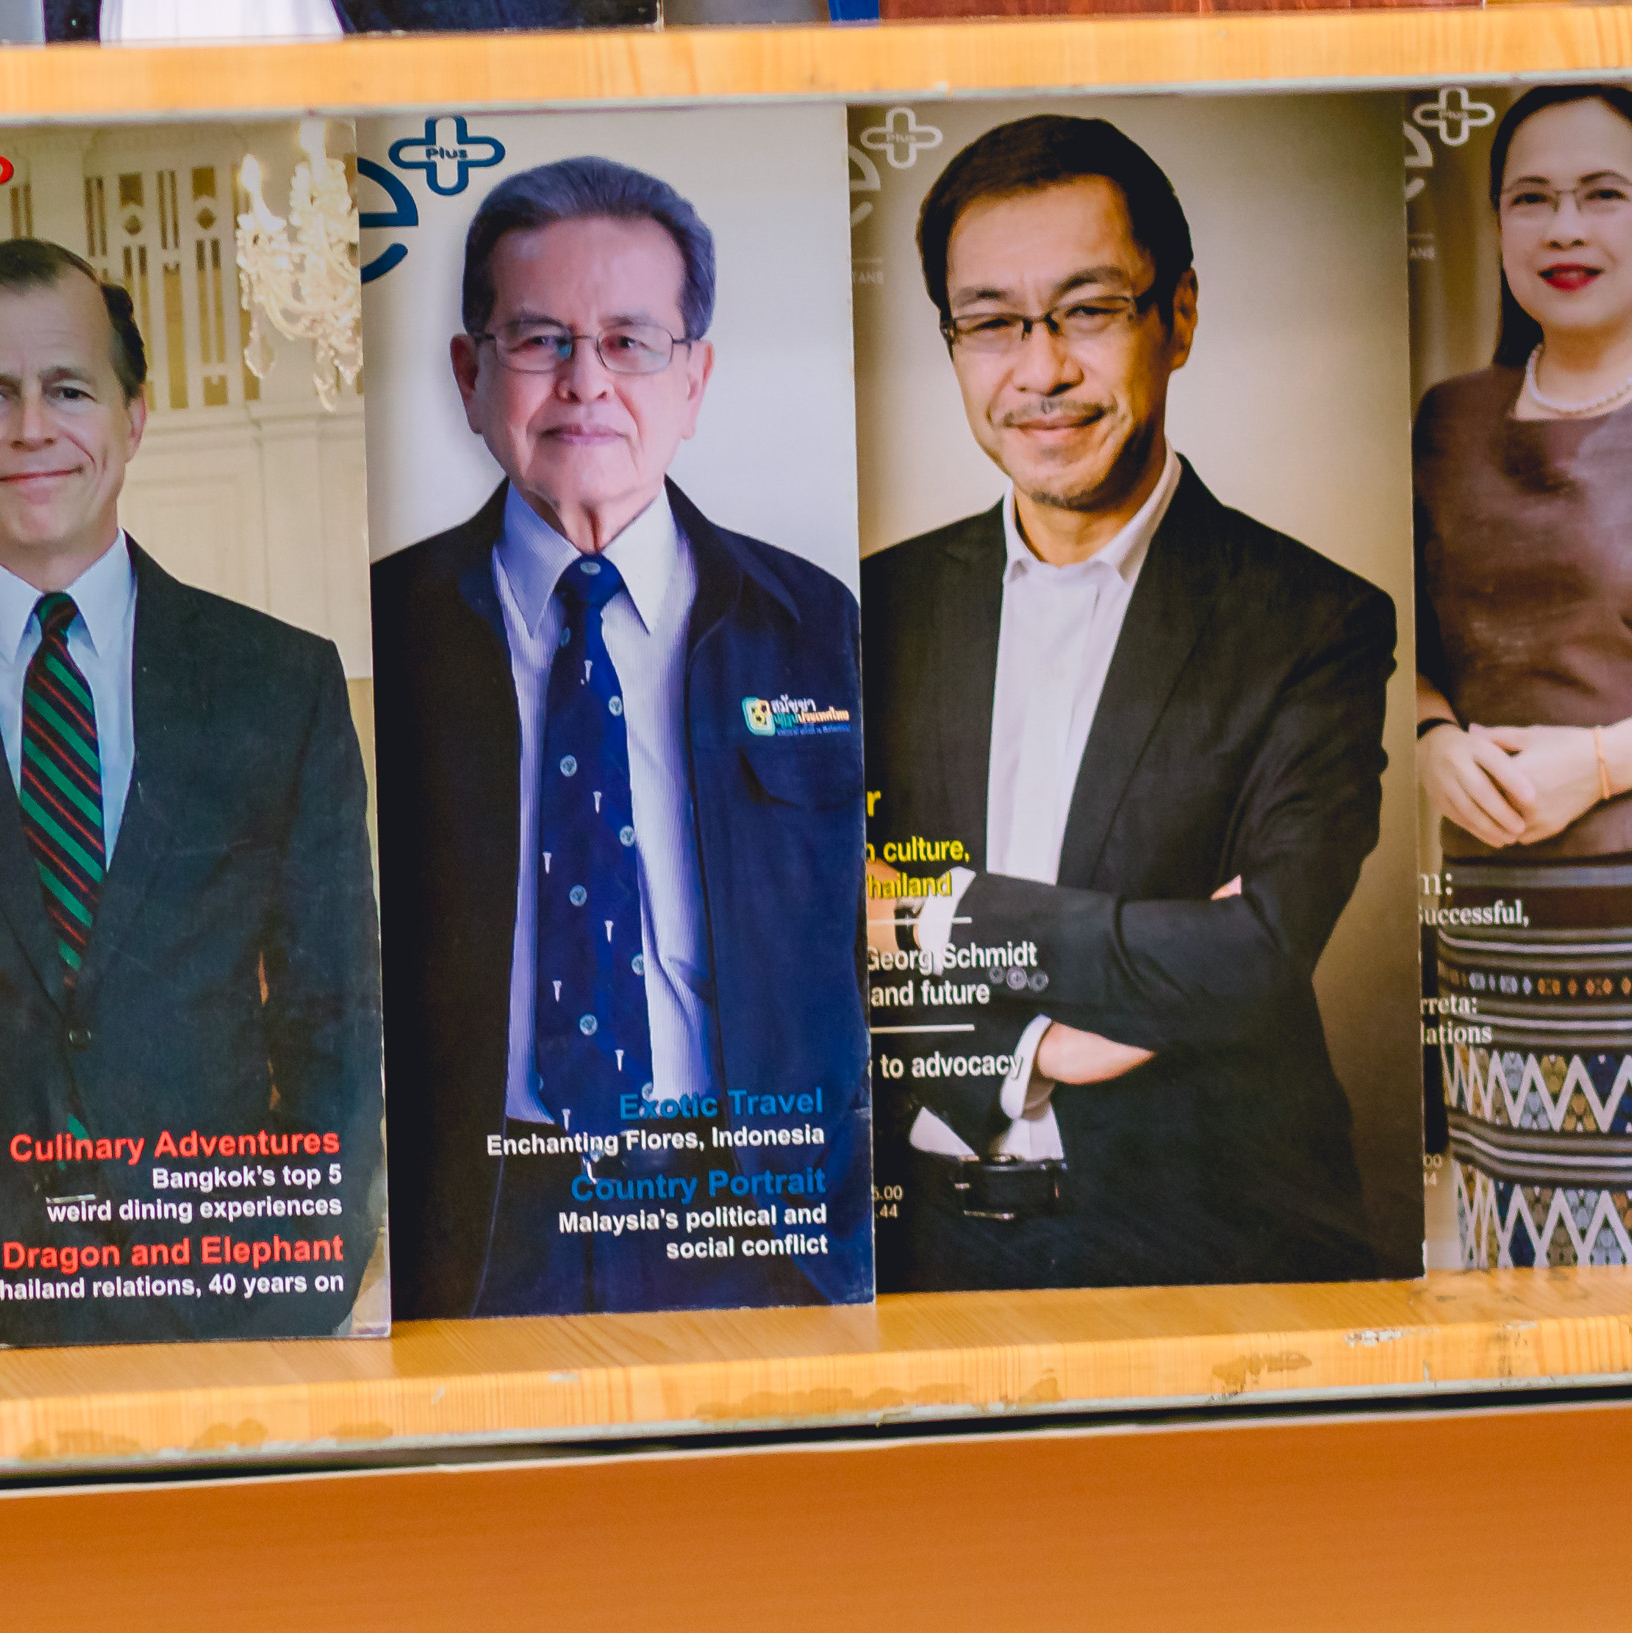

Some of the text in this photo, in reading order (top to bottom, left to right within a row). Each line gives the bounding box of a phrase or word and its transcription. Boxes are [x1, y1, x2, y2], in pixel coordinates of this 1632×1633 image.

[424, 146, 469, 161] Plus
[883, 836, 970, 863] culture,
[942, 941, 1038, 969] Schmidt
[871, 979, 990, 1007] and future
[880, 1050, 1023, 1080] to advocacy
[619, 1087, 823, 1120] Exotic Travel
[9, 1129, 341, 1165] Culinary Adventures
[486, 1124, 825, 1157] Enchanting Flores, Indonesia
[152, 1164, 341, 1193] Bangkok's top 5
[571, 1167, 826, 1205] Country Portrait
[46, 1197, 342, 1226] weird dining experiences
[558, 1204, 827, 1236] Malaysia's political and
[2, 1234, 344, 1275] Dragon and Elephant
[666, 1234, 828, 1260] social conflict
[92, 1274, 344, 1300] relations, 40 years on
